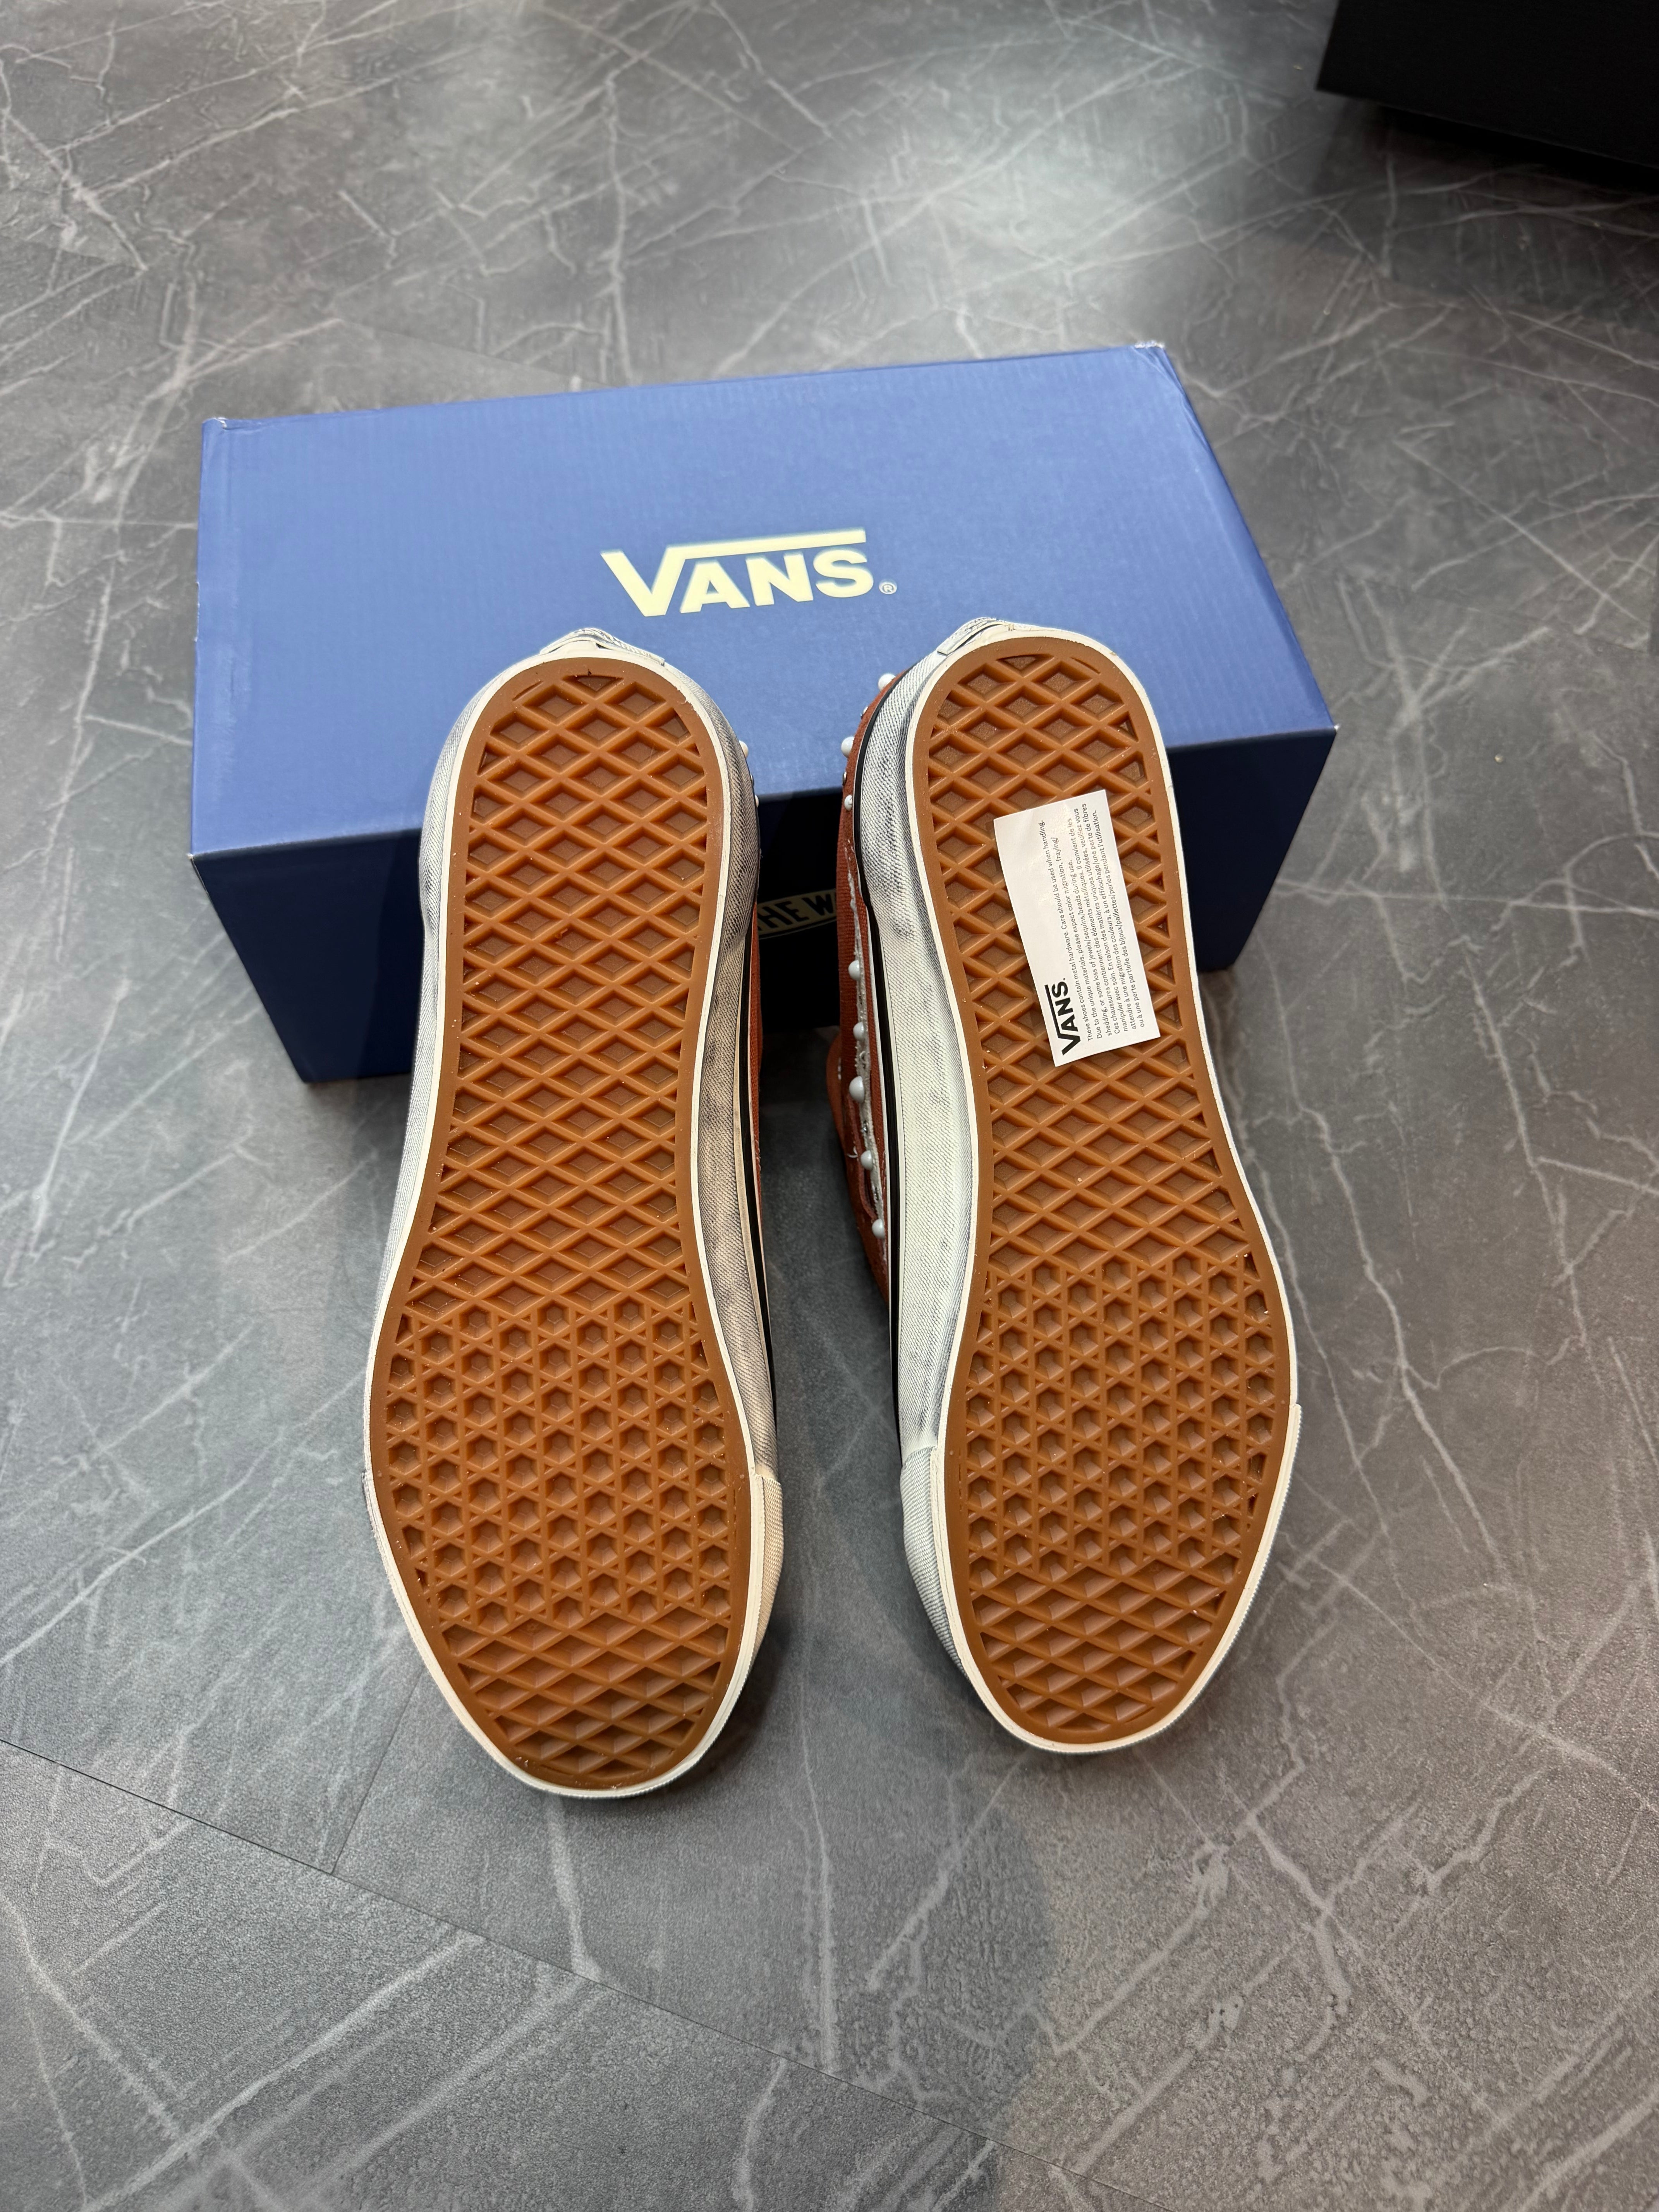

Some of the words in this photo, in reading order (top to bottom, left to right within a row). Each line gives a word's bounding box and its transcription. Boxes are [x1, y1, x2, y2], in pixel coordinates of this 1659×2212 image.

[1038, 820, 1048, 849] handling.
[1068, 828, 1075, 836] de
[1084, 823, 1091, 831] de
[1070, 837, 1081, 864] convient
[1087, 832, 1097, 850] perte
[1099, 847, 1111, 874] pendant
[1048, 867, 1056, 883] used
[1070, 873, 1079, 894] during
[1053, 884, 1058, 892] be
[1089, 877, 1098, 901] uniques
[1053, 893, 1063, 914] should
[1103, 900, 1108, 908] un
[758, 901, 809, 931] HE
[1068, 911, 1078, 933] expect
[1106, 914, 1116, 943] couleurs,
[1064, 930, 1074, 962] hardware.
[1074, 933, 1084, 953] please
[1103, 942, 1112, 961] raison
[1069, 962, 1079, 979] metal
[1078, 954, 1090, 984] materials,
[1096, 949, 1109, 986] contiennent
[1107, 962, 1114, 970] En
[1115, 955, 1126, 985] migration
[1123, 958, 1135, 983] partielle
[1074, 980, 1084, 1003] contain
[1086, 986, 1095, 1006] unique
[1130, 984, 1140, 1001] perte
[1080, 1004, 1089, 1022] shoes
[1105, 986, 1117, 1021] chaussures
[1101, 1006, 1112, 1036] shedding,
[1117, 1002, 1128, 1031] manipuler
[1126, 1003, 1136, 1029] attendre
[1139, 1019, 1145, 1027] ou
